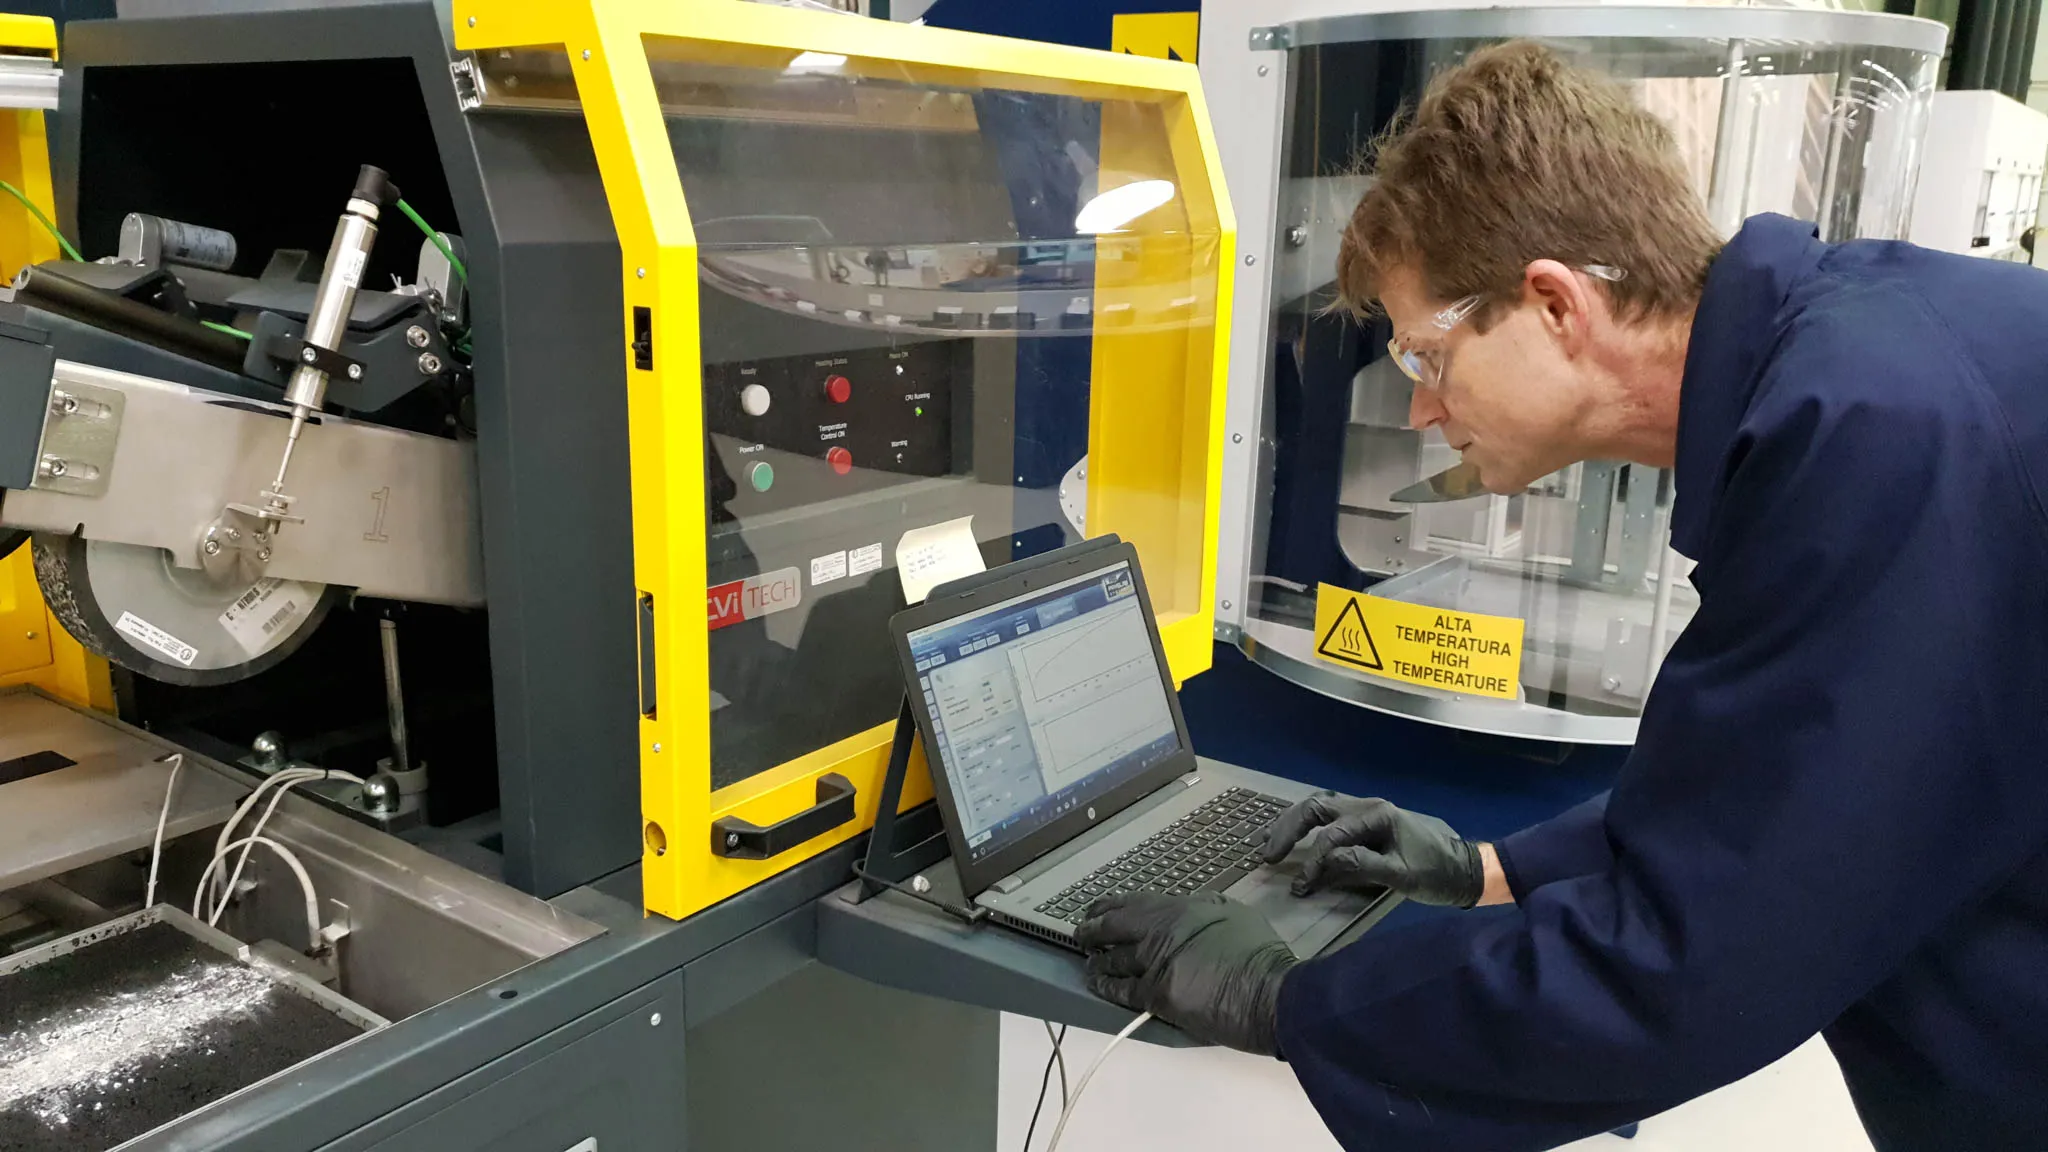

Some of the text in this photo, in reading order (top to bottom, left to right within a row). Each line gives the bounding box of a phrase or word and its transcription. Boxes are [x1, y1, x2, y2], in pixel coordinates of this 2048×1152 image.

[818, 422, 848, 432] Temperature
[820, 430, 846, 441] Control ON
[739, 443, 764, 454] Power ON
[890, 439, 908, 448] Warning
[363, 486, 390, 542] 1
[746, 576, 796, 608] TECH
[1434, 615, 1472, 633] ALTA
[1396, 625, 1511, 656] TEMPERATURA
[1431, 650, 1469, 669] HIGH
[1393, 660, 1507, 692] TEMPERATURE
